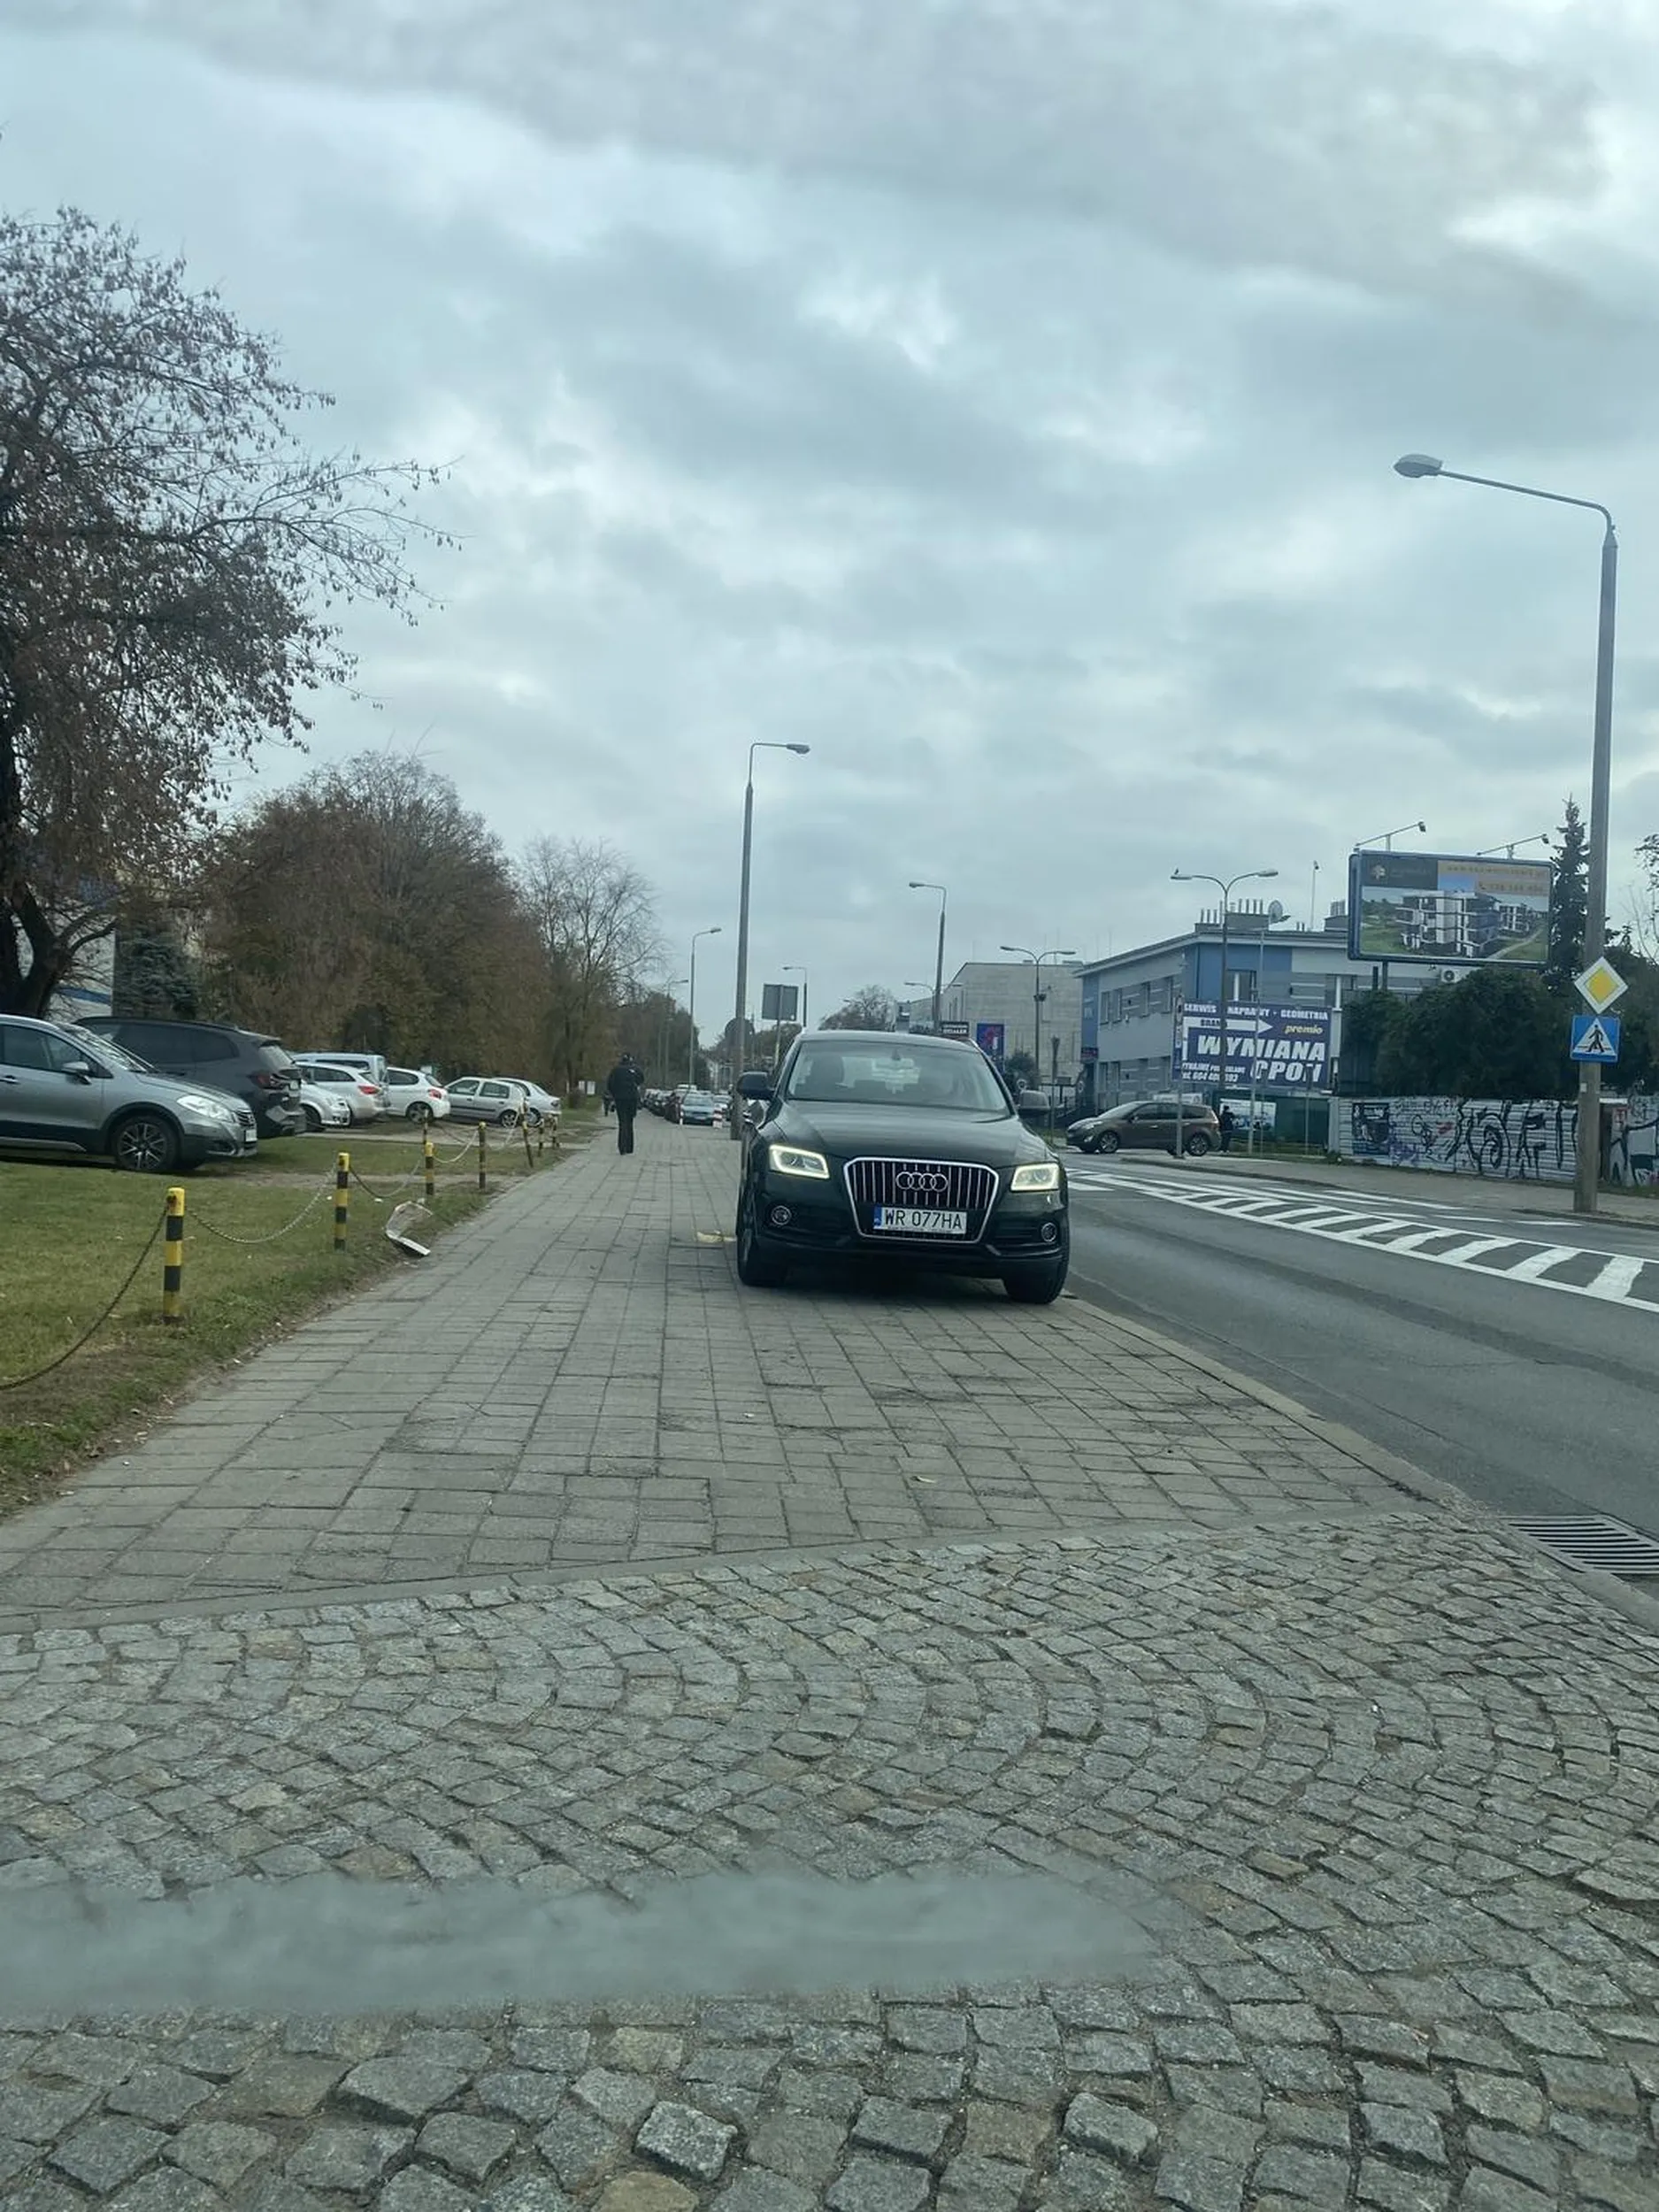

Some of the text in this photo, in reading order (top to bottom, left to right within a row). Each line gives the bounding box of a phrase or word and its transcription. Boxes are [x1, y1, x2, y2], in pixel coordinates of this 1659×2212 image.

[1184, 1002, 1217, 1013] SERWIS
[1280, 1009, 1328, 1021] GEOMETRIA
[1284, 1025, 1323, 1034] premio
[1197, 1034, 1325, 1062] WYMIANA
[885, 1209, 962, 1230] WR 077HA
